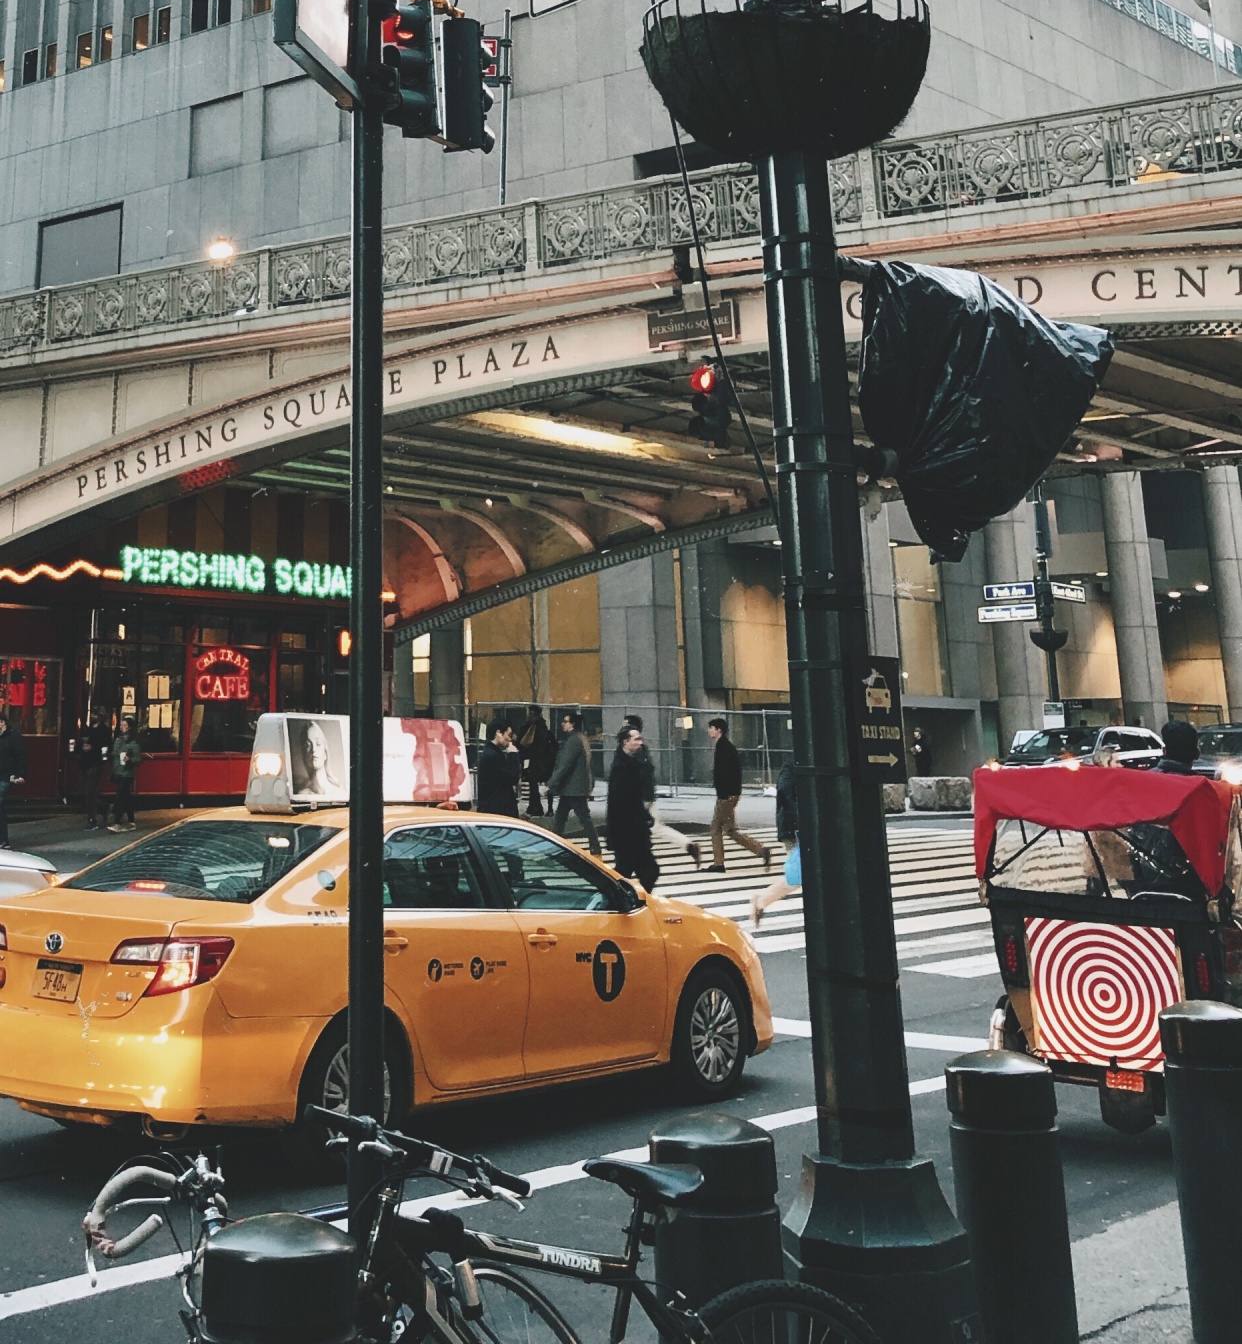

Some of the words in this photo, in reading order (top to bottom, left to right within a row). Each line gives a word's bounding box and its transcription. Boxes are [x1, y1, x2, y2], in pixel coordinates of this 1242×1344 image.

[652, 321, 693, 335] PERSHING
[76, 417, 239, 499] PERSHING
[262, 370, 403, 431] SQUAE
[432, 335, 561, 385] PLAZA
[121, 545, 266, 593] PERSHING
[273, 557, 352, 599] SQUA
[992, 587, 1010, 597] Park
[125, 689, 133, 700] A
[861, 725, 878, 739] TAXI
[879, 725, 900, 740] STAND
[576, 952, 592, 963] NYC
[600, 952, 618, 994] T
[538, 1246, 601, 1273] TUNDRA
